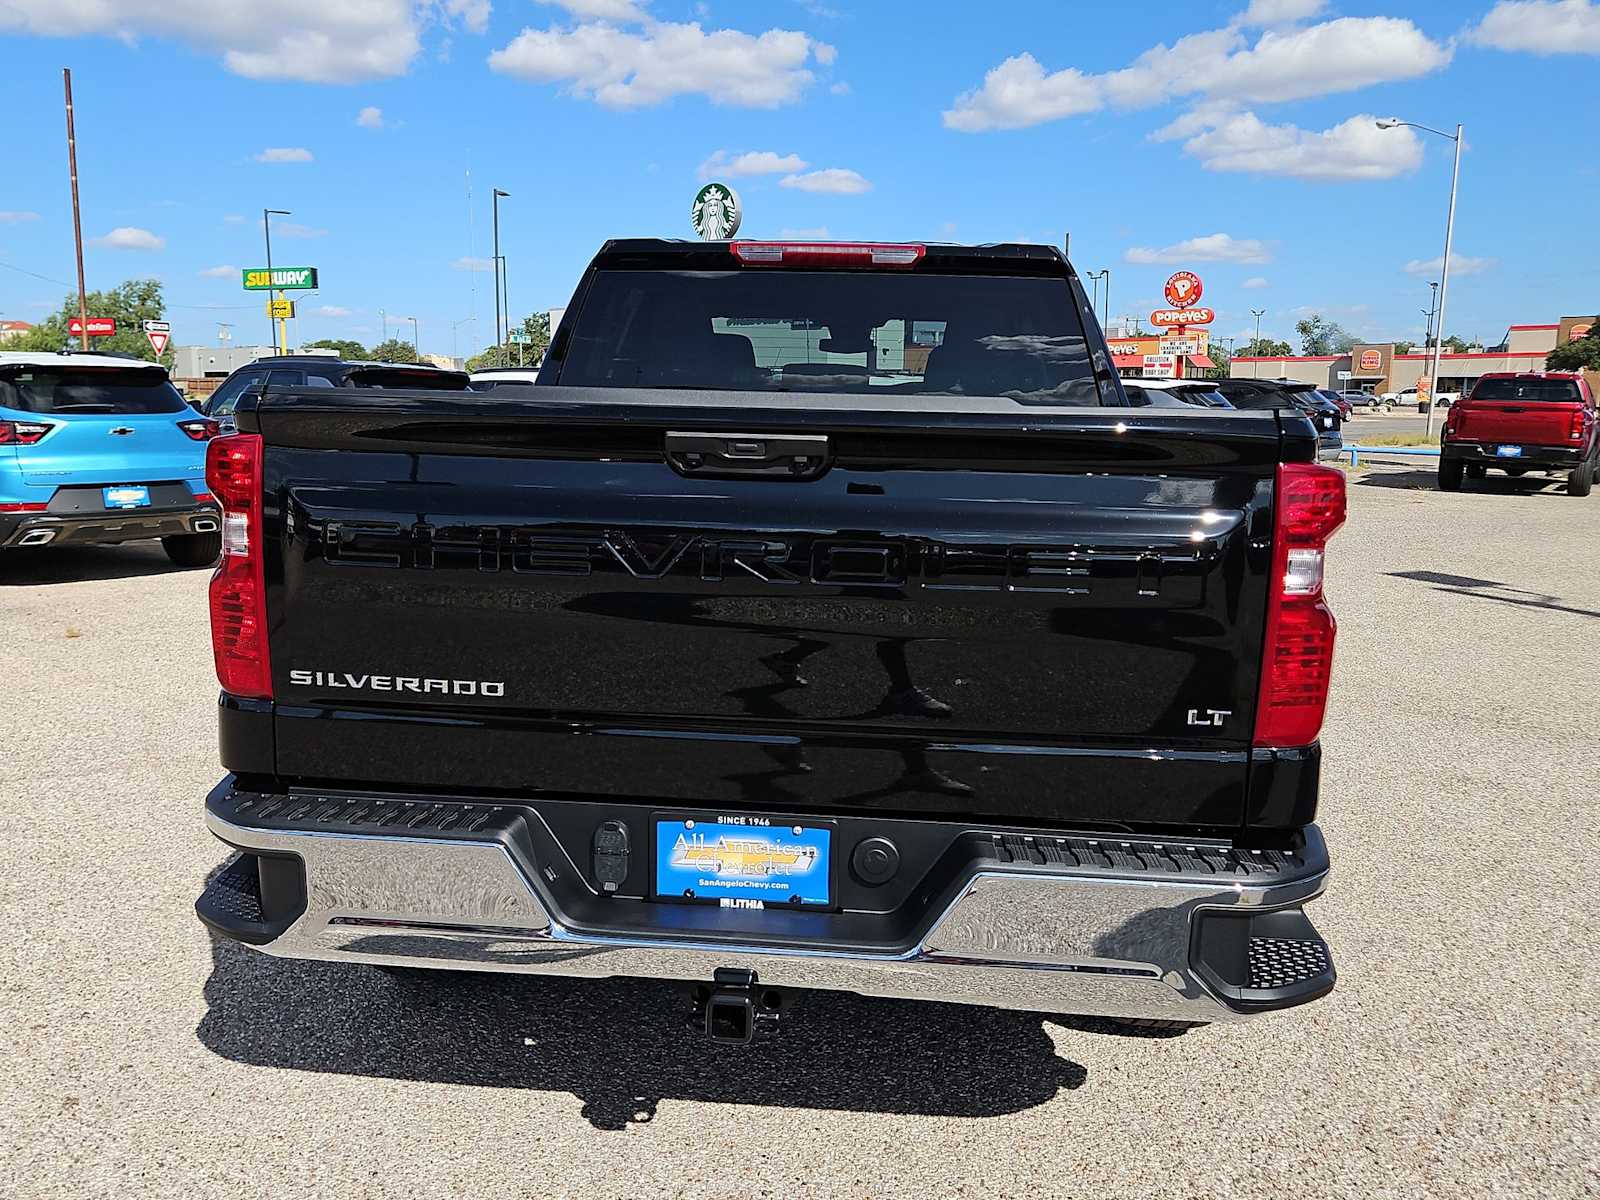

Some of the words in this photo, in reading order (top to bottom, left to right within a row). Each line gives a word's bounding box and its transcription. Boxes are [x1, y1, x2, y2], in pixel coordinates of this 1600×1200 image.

[322, 519, 1202, 597] CHEVROLET
[289, 669, 505, 697] SILVERADO
[1187, 708, 1232, 726] LT
[717, 815, 746, 825] SINCE
[748, 817, 771, 826] 1946
[672, 832, 704, 850] All
[714, 835, 818, 856] American
[695, 853, 793, 876] Chevrolet
[698, 878, 789, 890] SanAngeloChevy.com
[730, 898, 765, 910] LITHIA
